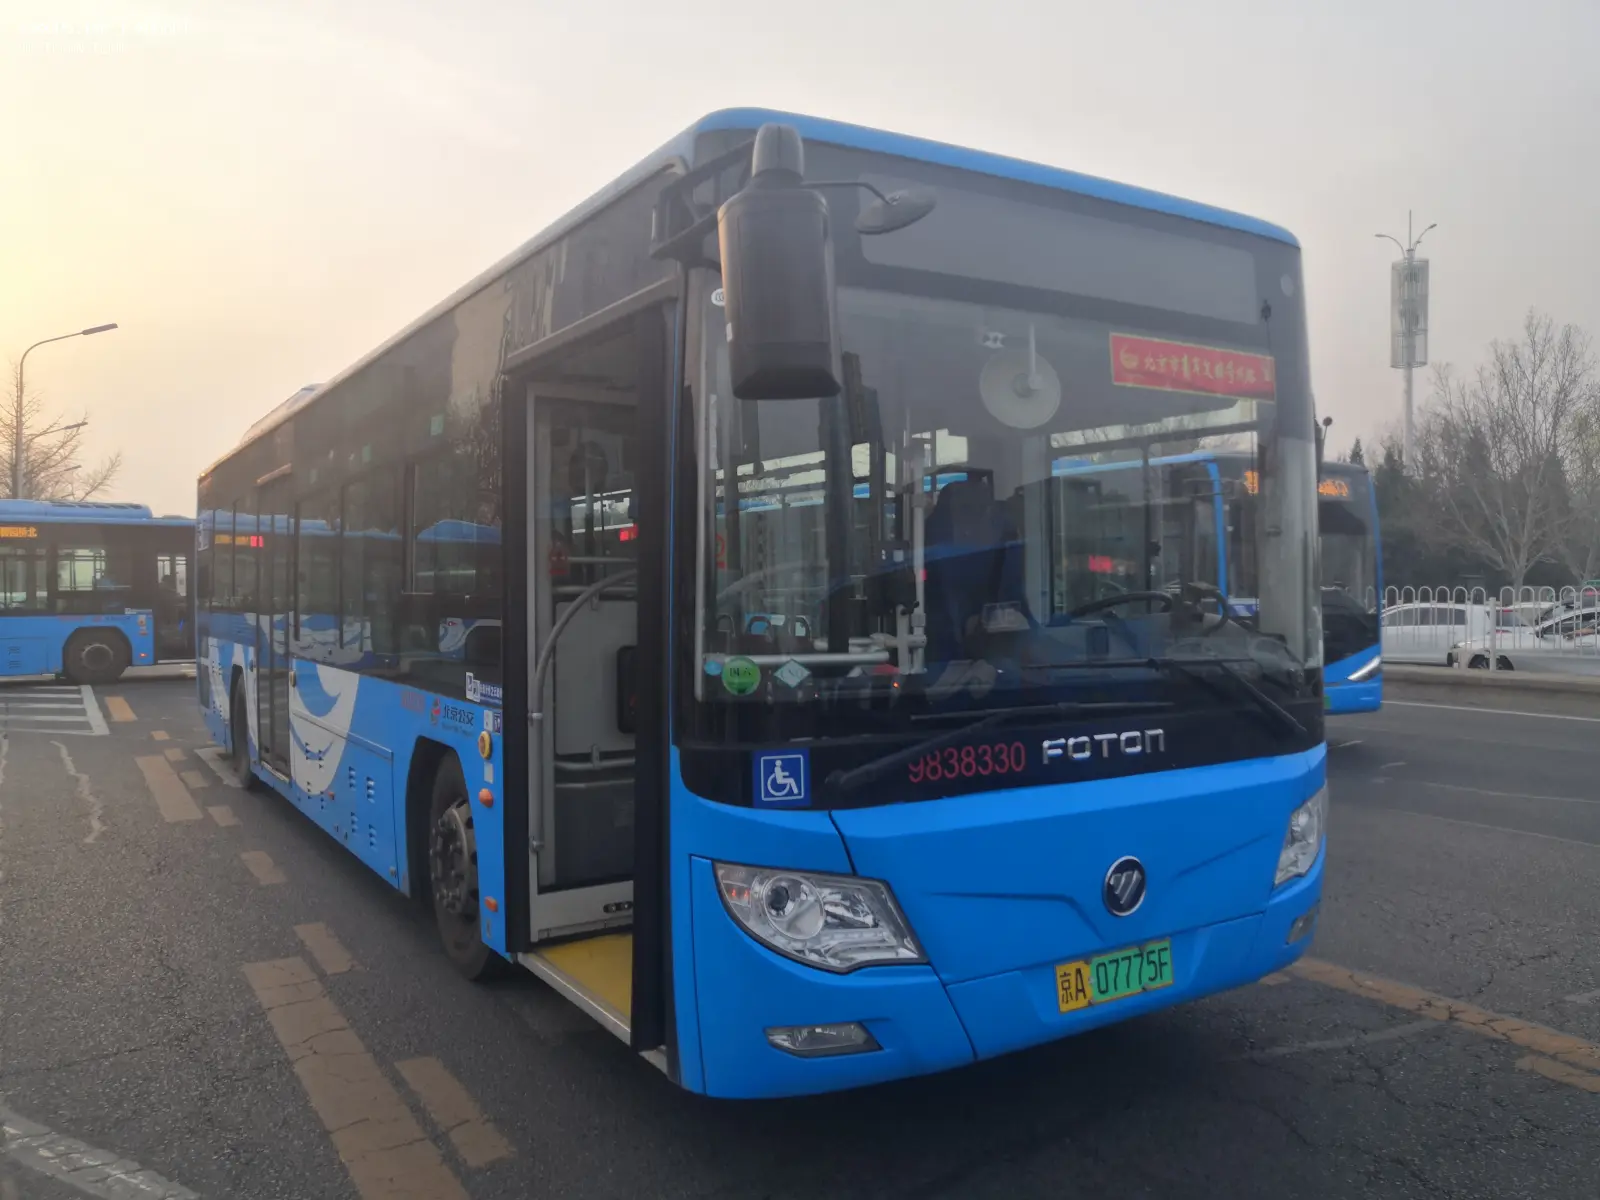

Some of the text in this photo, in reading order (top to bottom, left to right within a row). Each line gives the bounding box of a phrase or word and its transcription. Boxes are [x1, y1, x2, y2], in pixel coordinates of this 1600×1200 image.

[443, 704, 475, 726] 北京公交
[908, 742, 1026, 783] 9838330
[1042, 728, 1165, 765] FOTON
